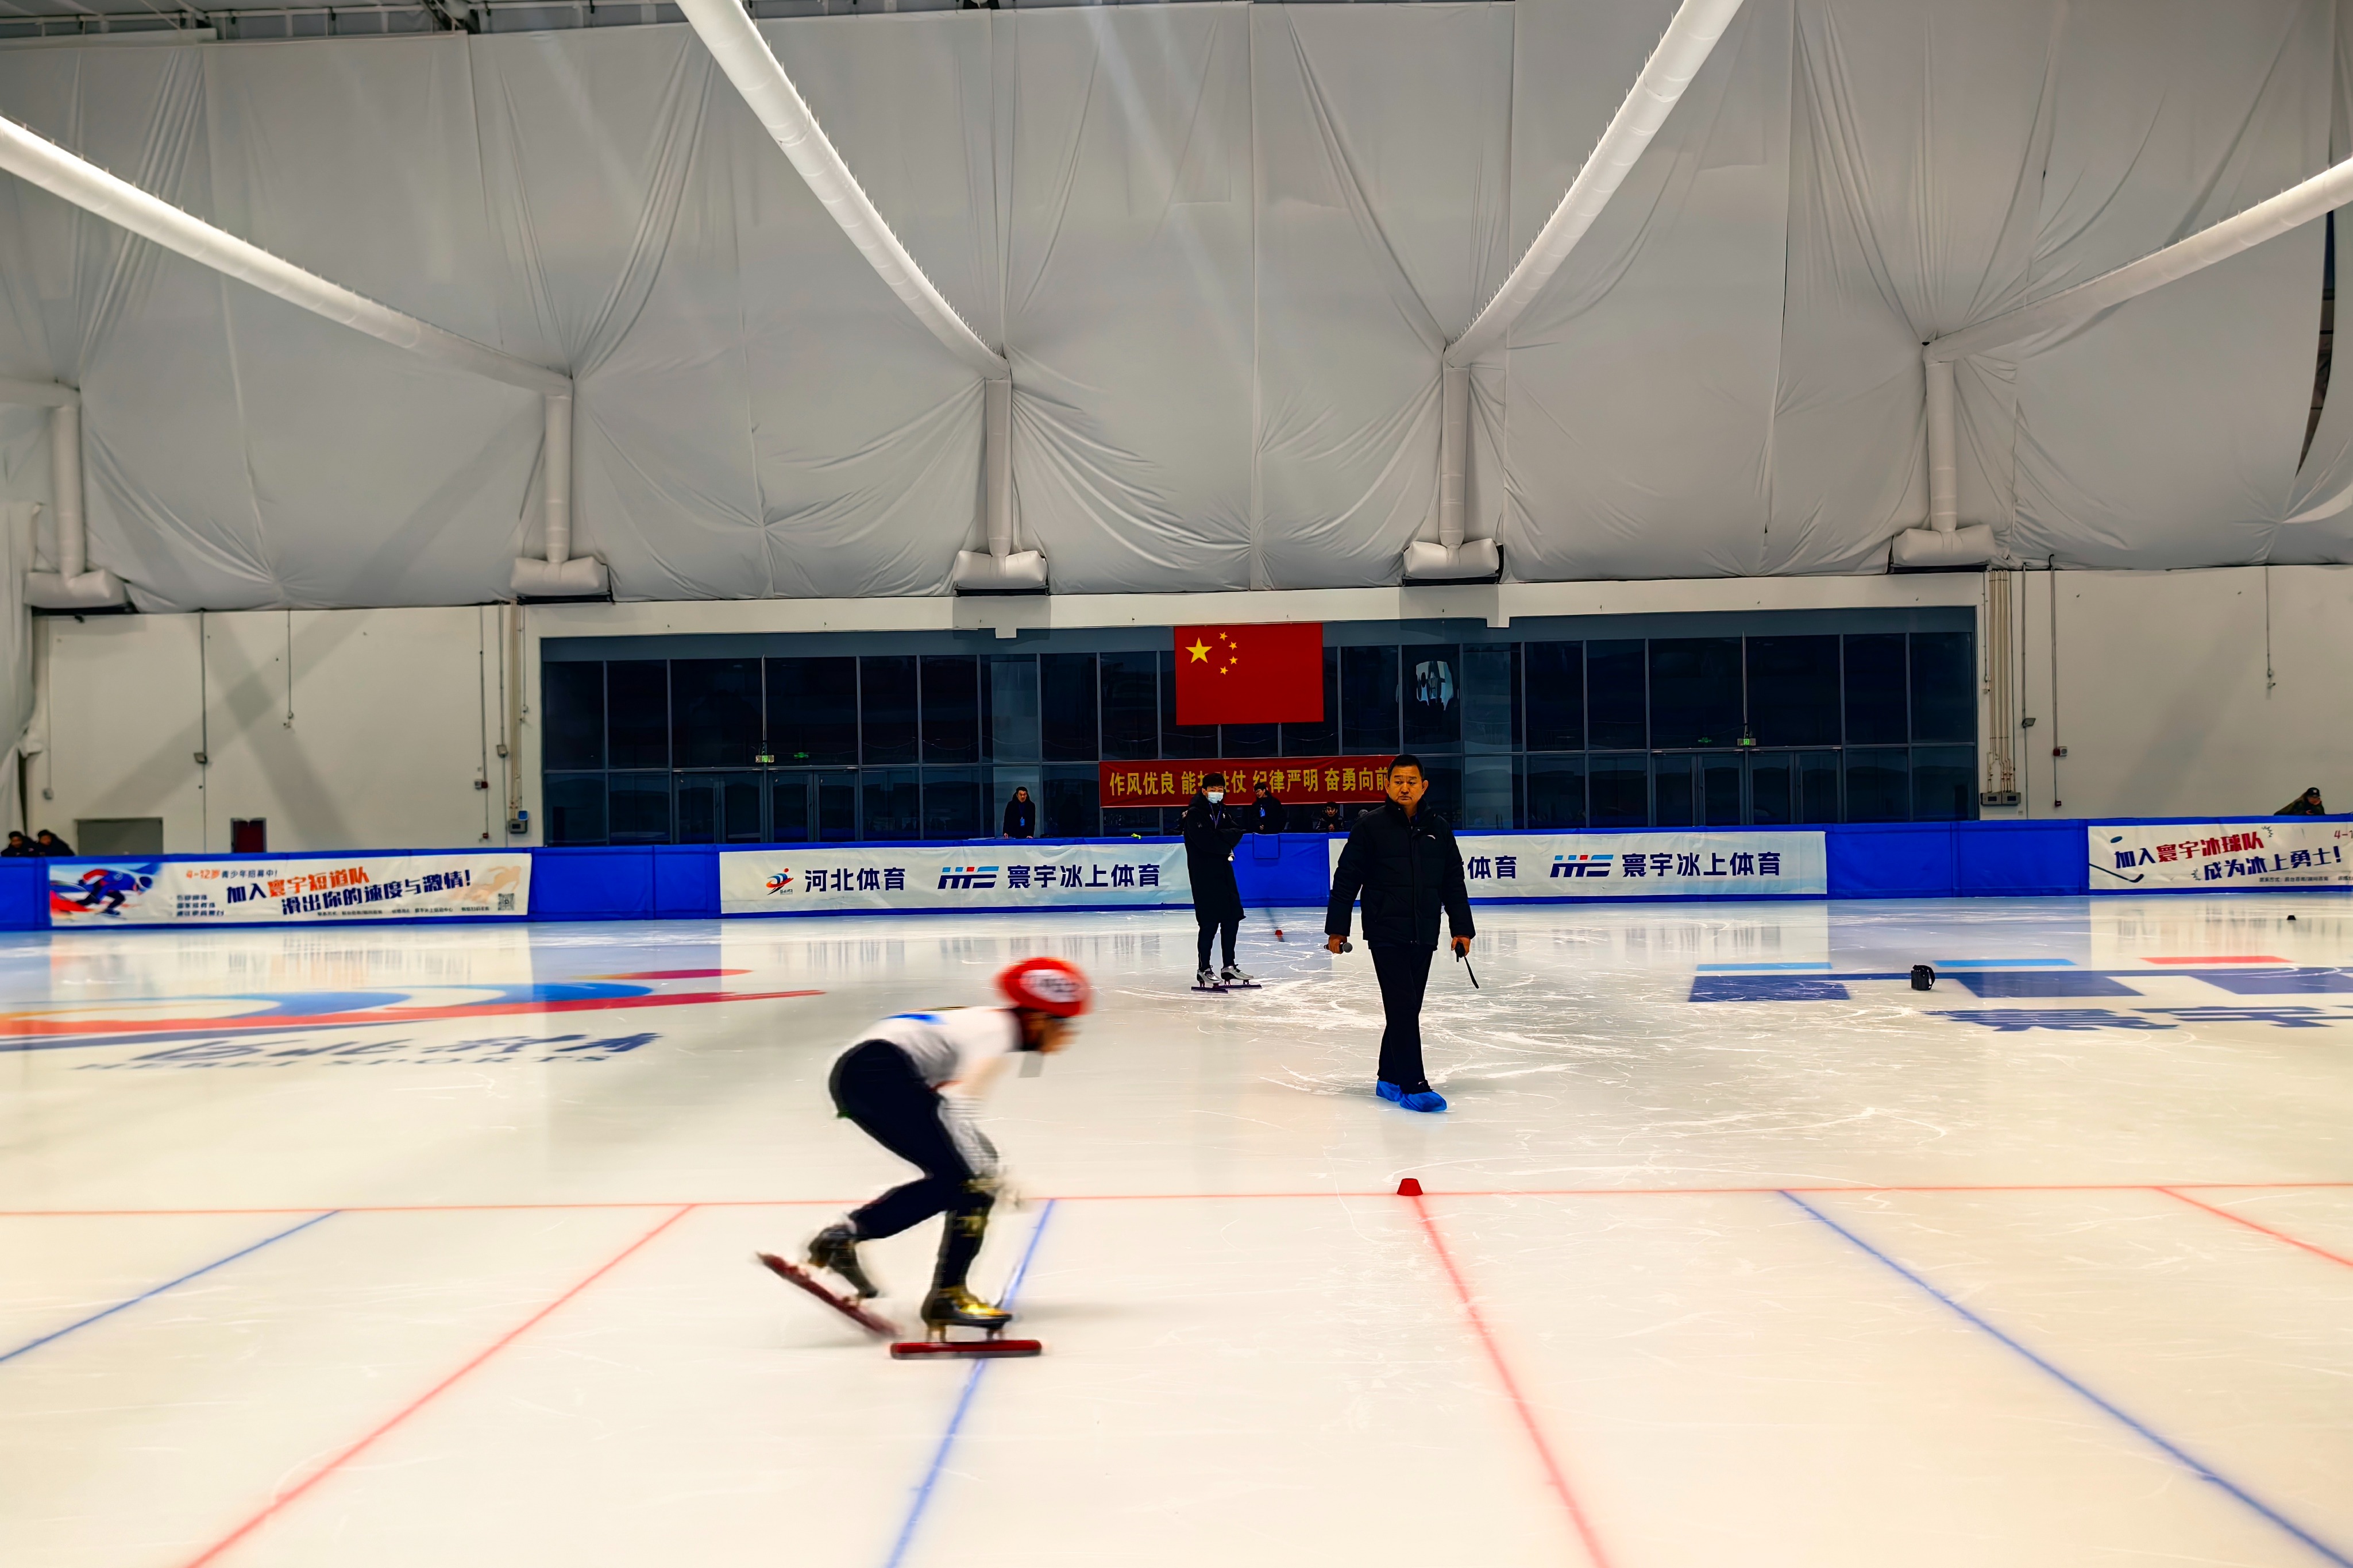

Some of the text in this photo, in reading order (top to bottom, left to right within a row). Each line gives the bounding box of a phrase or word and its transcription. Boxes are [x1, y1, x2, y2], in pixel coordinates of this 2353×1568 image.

[1110, 771, 1175, 795] 作风优良
[1253, 768, 1318, 793] 纪律严明
[2114, 831, 2265, 869] 加入寰宇冰球队
[2204, 845, 2342, 880] 成为冰上勇士!
[1007, 863, 1160, 889] 寰宇冰上体育
[1462, 855, 1517, 879] 体育
[1622, 851, 1781, 878] 寰宇冰上体育
[226, 866, 370, 904] 加入寰宇短道队
[281, 868, 471, 915] 滑出你的速度与激情!
[805, 867, 905, 893] 河北体育
[1920, 1005, 2353, 1032] 寰宇
[321, 1055, 614, 1066] SPORTS
